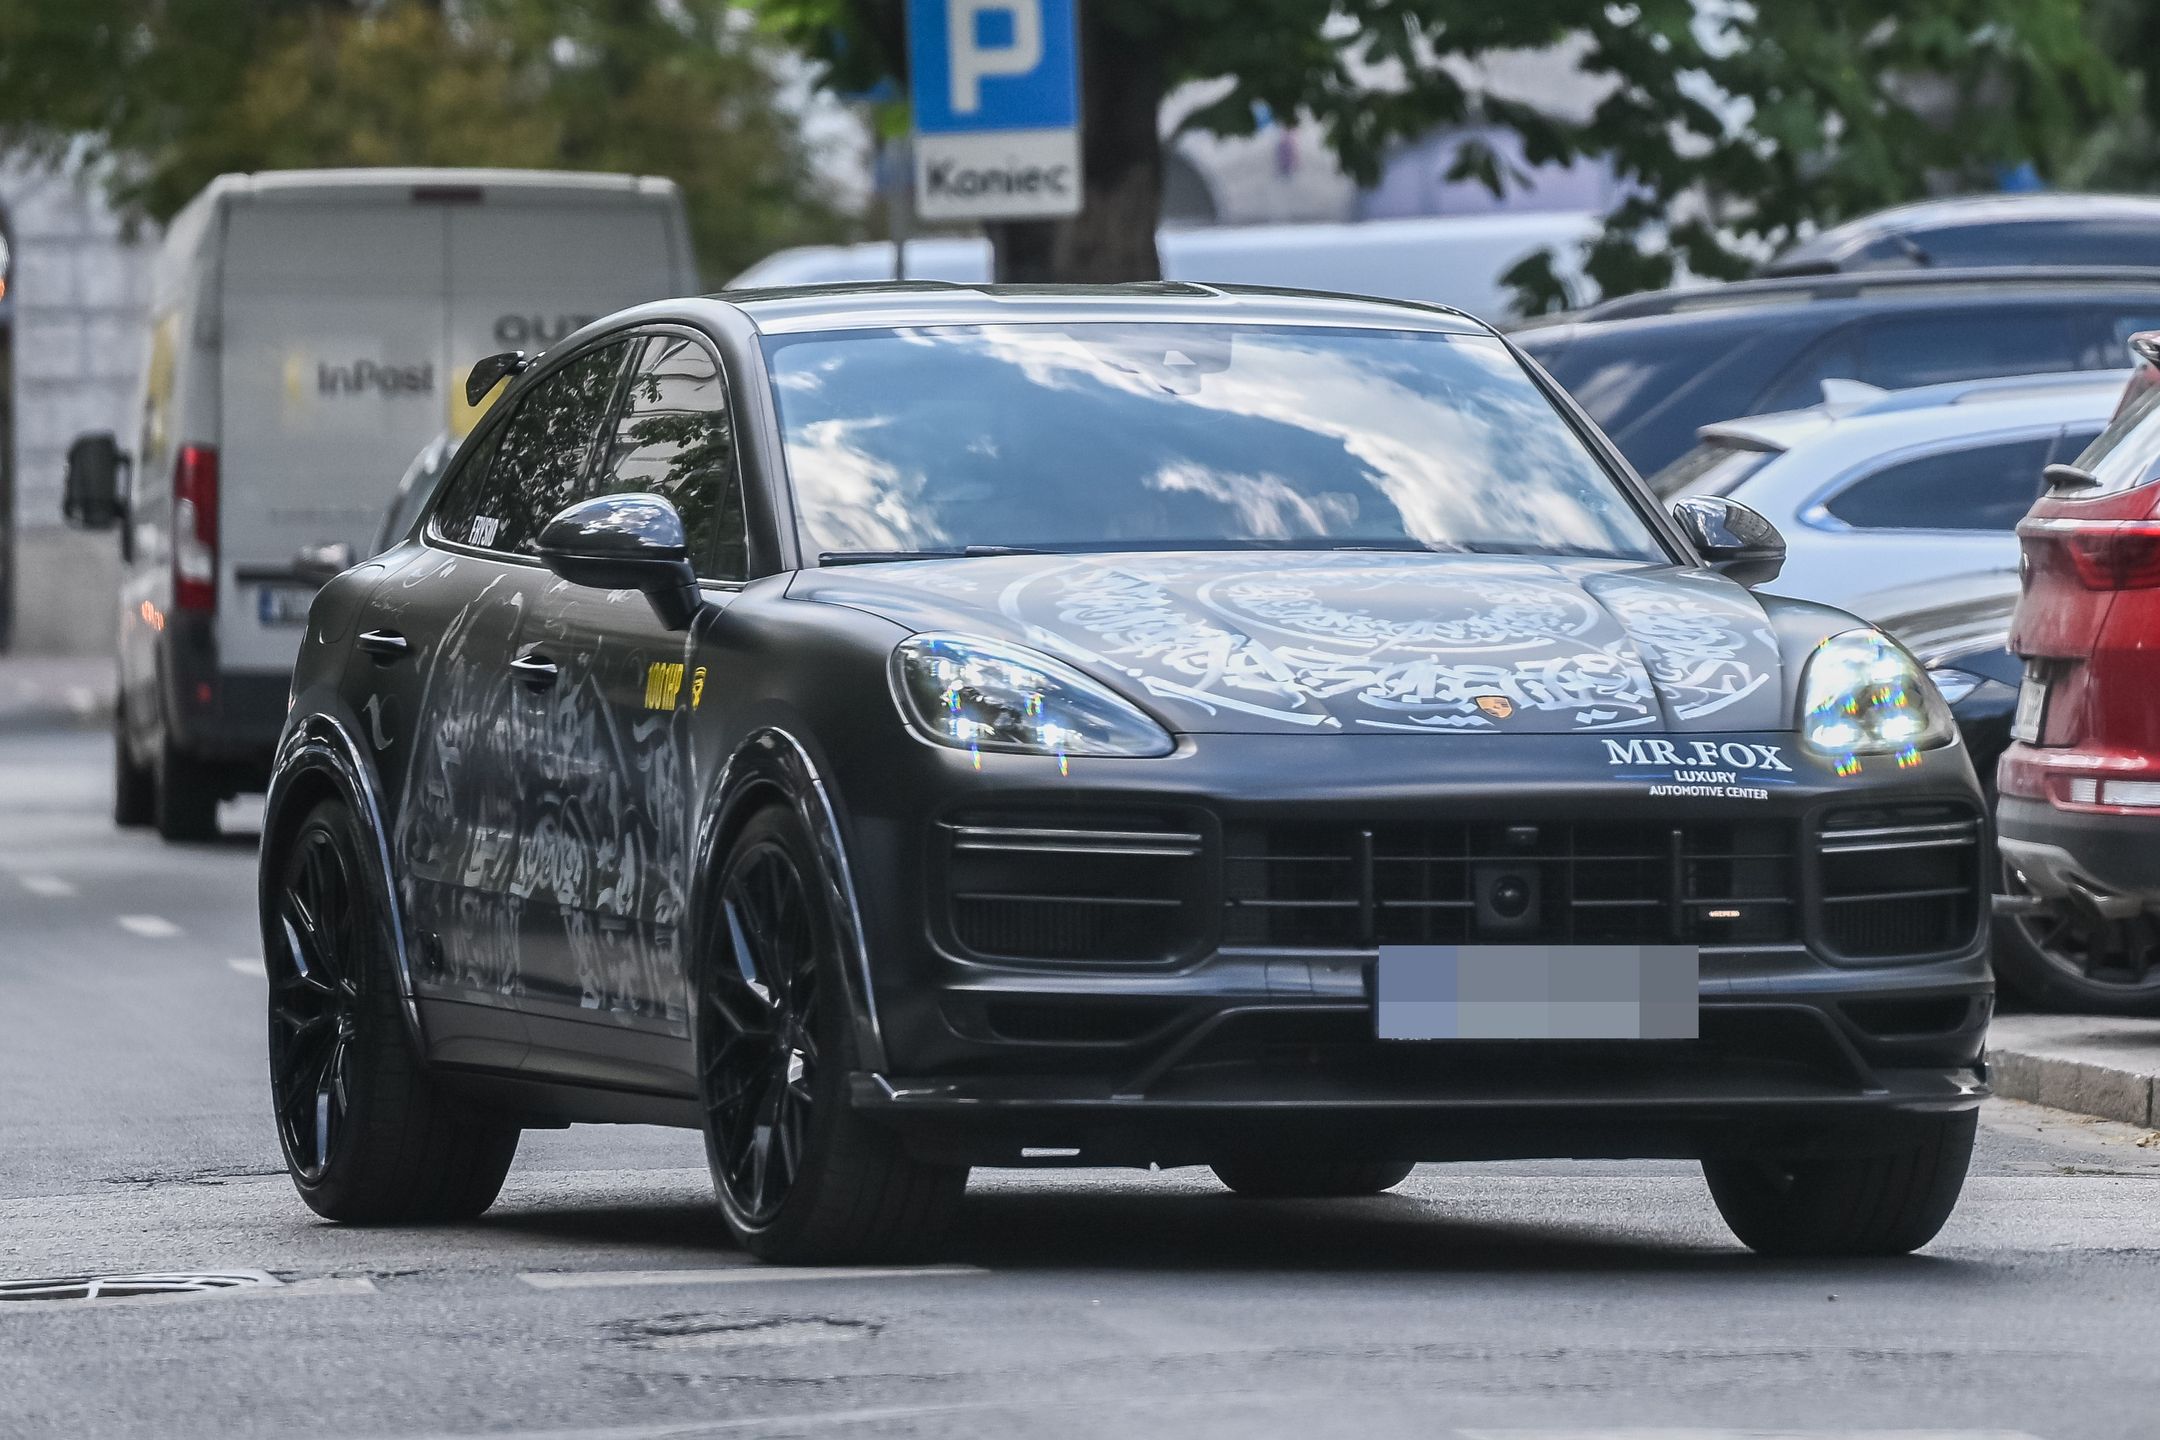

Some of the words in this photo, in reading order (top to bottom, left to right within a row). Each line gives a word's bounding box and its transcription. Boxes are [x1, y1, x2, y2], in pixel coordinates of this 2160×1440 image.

[947, 0, 1043, 114] P
[926, 156, 1069, 197] Koniec
[318, 359, 433, 397] InPost
[1601, 739, 1793, 772] MR.FOX
[1649, 785, 1725, 797] AUTOMOTIVE
[1725, 786, 1768, 800] CENTER
[1673, 769, 1737, 784] LUXURY
